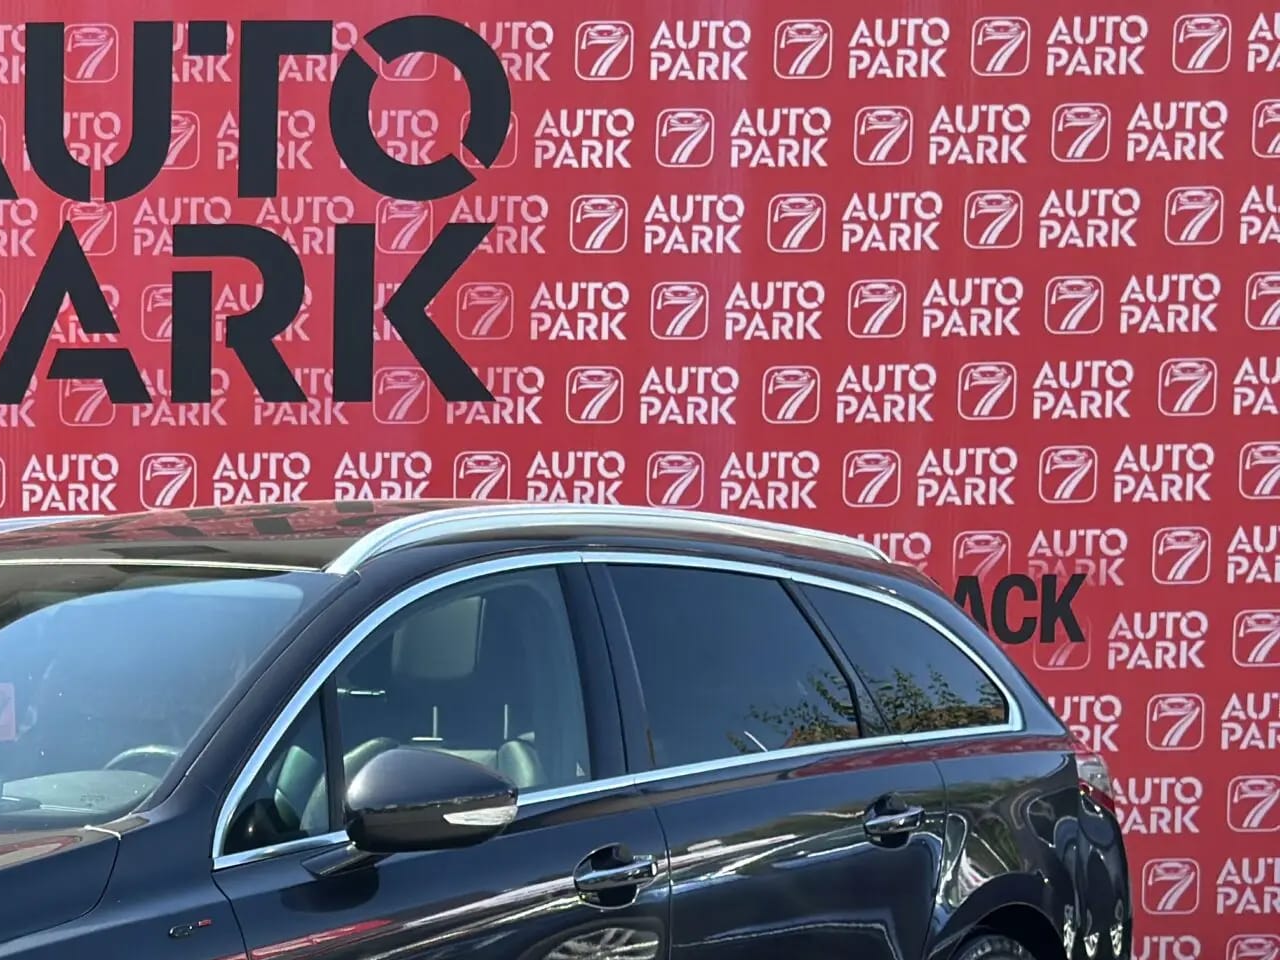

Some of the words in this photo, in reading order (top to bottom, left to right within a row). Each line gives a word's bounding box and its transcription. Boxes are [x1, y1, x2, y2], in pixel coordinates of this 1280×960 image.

[650, 20, 751, 49] AUTO
[849, 17, 949, 47] AUTO
[1047, 15, 1148, 44] AUTO
[651, 51, 747, 80] PARK
[849, 48, 946, 78] PARK
[1047, 46, 1144, 75] PARK
[535, 109, 634, 137] AUTO
[731, 107, 831, 136] AUTO
[929, 104, 1030, 134] AUTO
[1127, 101, 1227, 130] AUTO
[535, 140, 631, 168] PARK
[731, 138, 827, 167] PARK
[929, 135, 1026, 164] PARK
[1127, 131, 1224, 161] PARK
[134, 197, 232, 226] AUTO
[256, 196, 354, 225] AUTO
[450, 195, 548, 223] AUTO
[645, 194, 744, 222] AUTO
[842, 191, 942, 221] AUTO
[1039, 188, 1140, 217] AUTO
[645, 225, 741, 253] PARK
[842, 222, 939, 251] PARK
[1040, 218, 1136, 248] PARK
[531, 282, 629, 309] AUTO
[726, 281, 824, 309] AUTO
[923, 277, 1023, 306] AUTO
[1120, 273, 1220, 303] AUTO
[531, 312, 626, 340] PARK
[726, 311, 821, 340] PARK
[923, 307, 1020, 337] PARK
[1120, 303, 1217, 333] PARK
[640, 366, 739, 394] AUTO
[837, 364, 936, 392] AUTO
[1033, 360, 1133, 389] AUTO
[133, 399, 228, 427] PARK
[254, 398, 349, 426] PARK
[447, 396, 542, 424] PARK
[641, 396, 736, 424] PARK
[838, 394, 933, 423] PARK
[1033, 389, 1130, 419] PARK
[22, 454, 118, 481] AUTO
[213, 452, 310, 480] AUTO
[335, 452, 431, 479] AUTO
[527, 451, 625, 478] AUTO
[721, 451, 819, 479] AUTO
[918, 447, 1017, 476] AUTO
[1115, 443, 1214, 472] AUTO
[22, 483, 118, 511] PARK
[721, 481, 816, 509] PARK
[918, 477, 1014, 506] PARK
[1115, 473, 1211, 502] PARK
[1028, 528, 1127, 557] AUTO
[1109, 611, 1208, 639] AUTO
[1109, 640, 1204, 669] PARK
